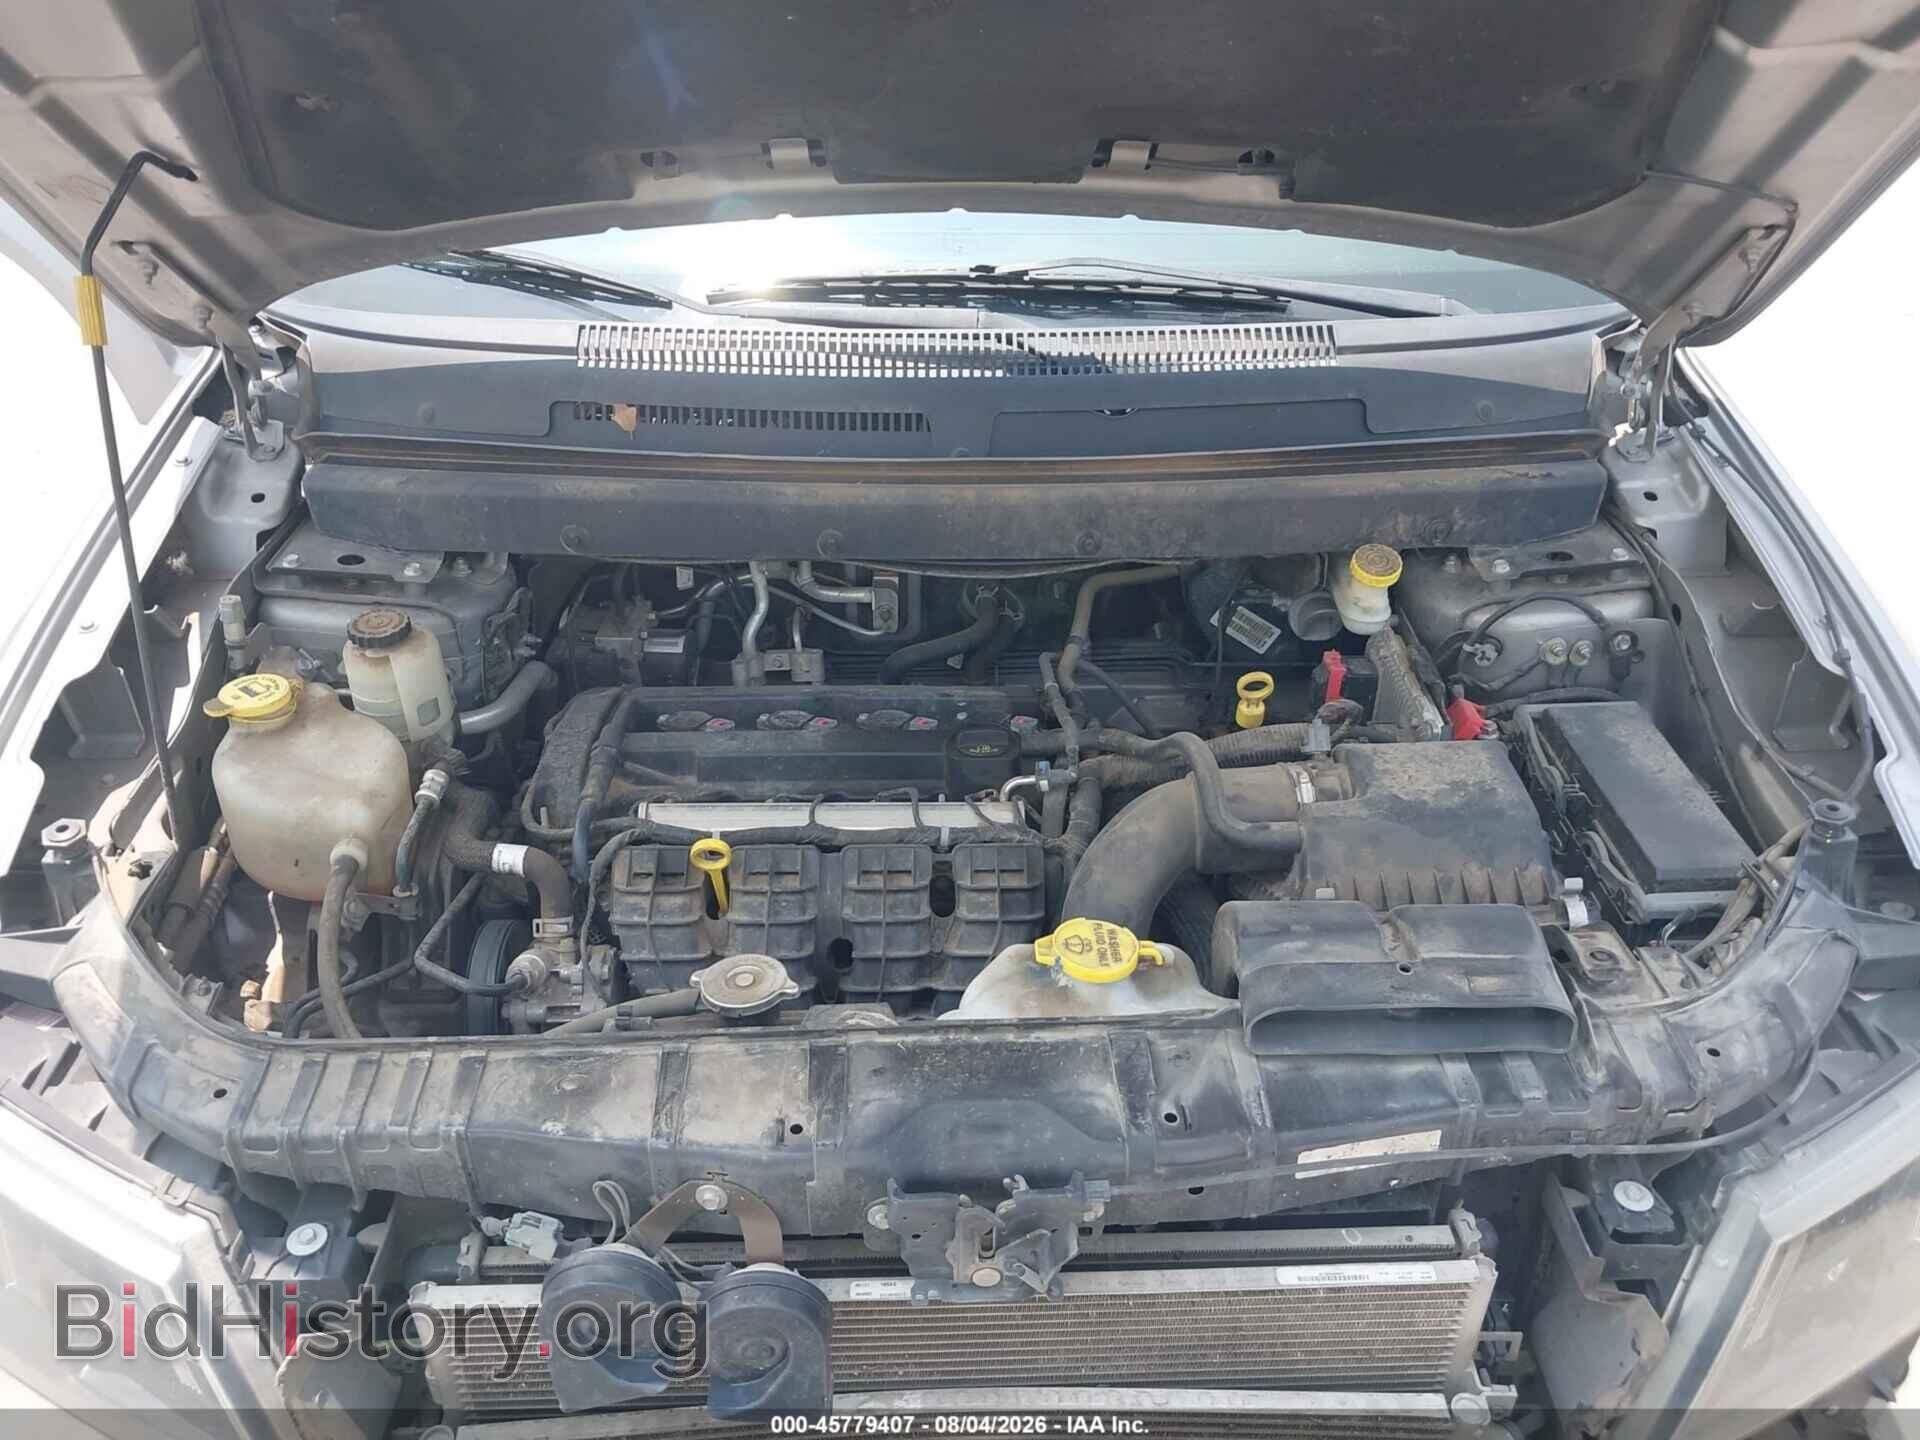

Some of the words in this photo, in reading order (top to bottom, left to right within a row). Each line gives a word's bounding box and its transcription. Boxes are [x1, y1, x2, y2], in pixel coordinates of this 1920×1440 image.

[1093, 923, 1107, 945] FLUID
[1107, 928, 1122, 963] WASHER
[1096, 947, 1111, 968] ONLY
